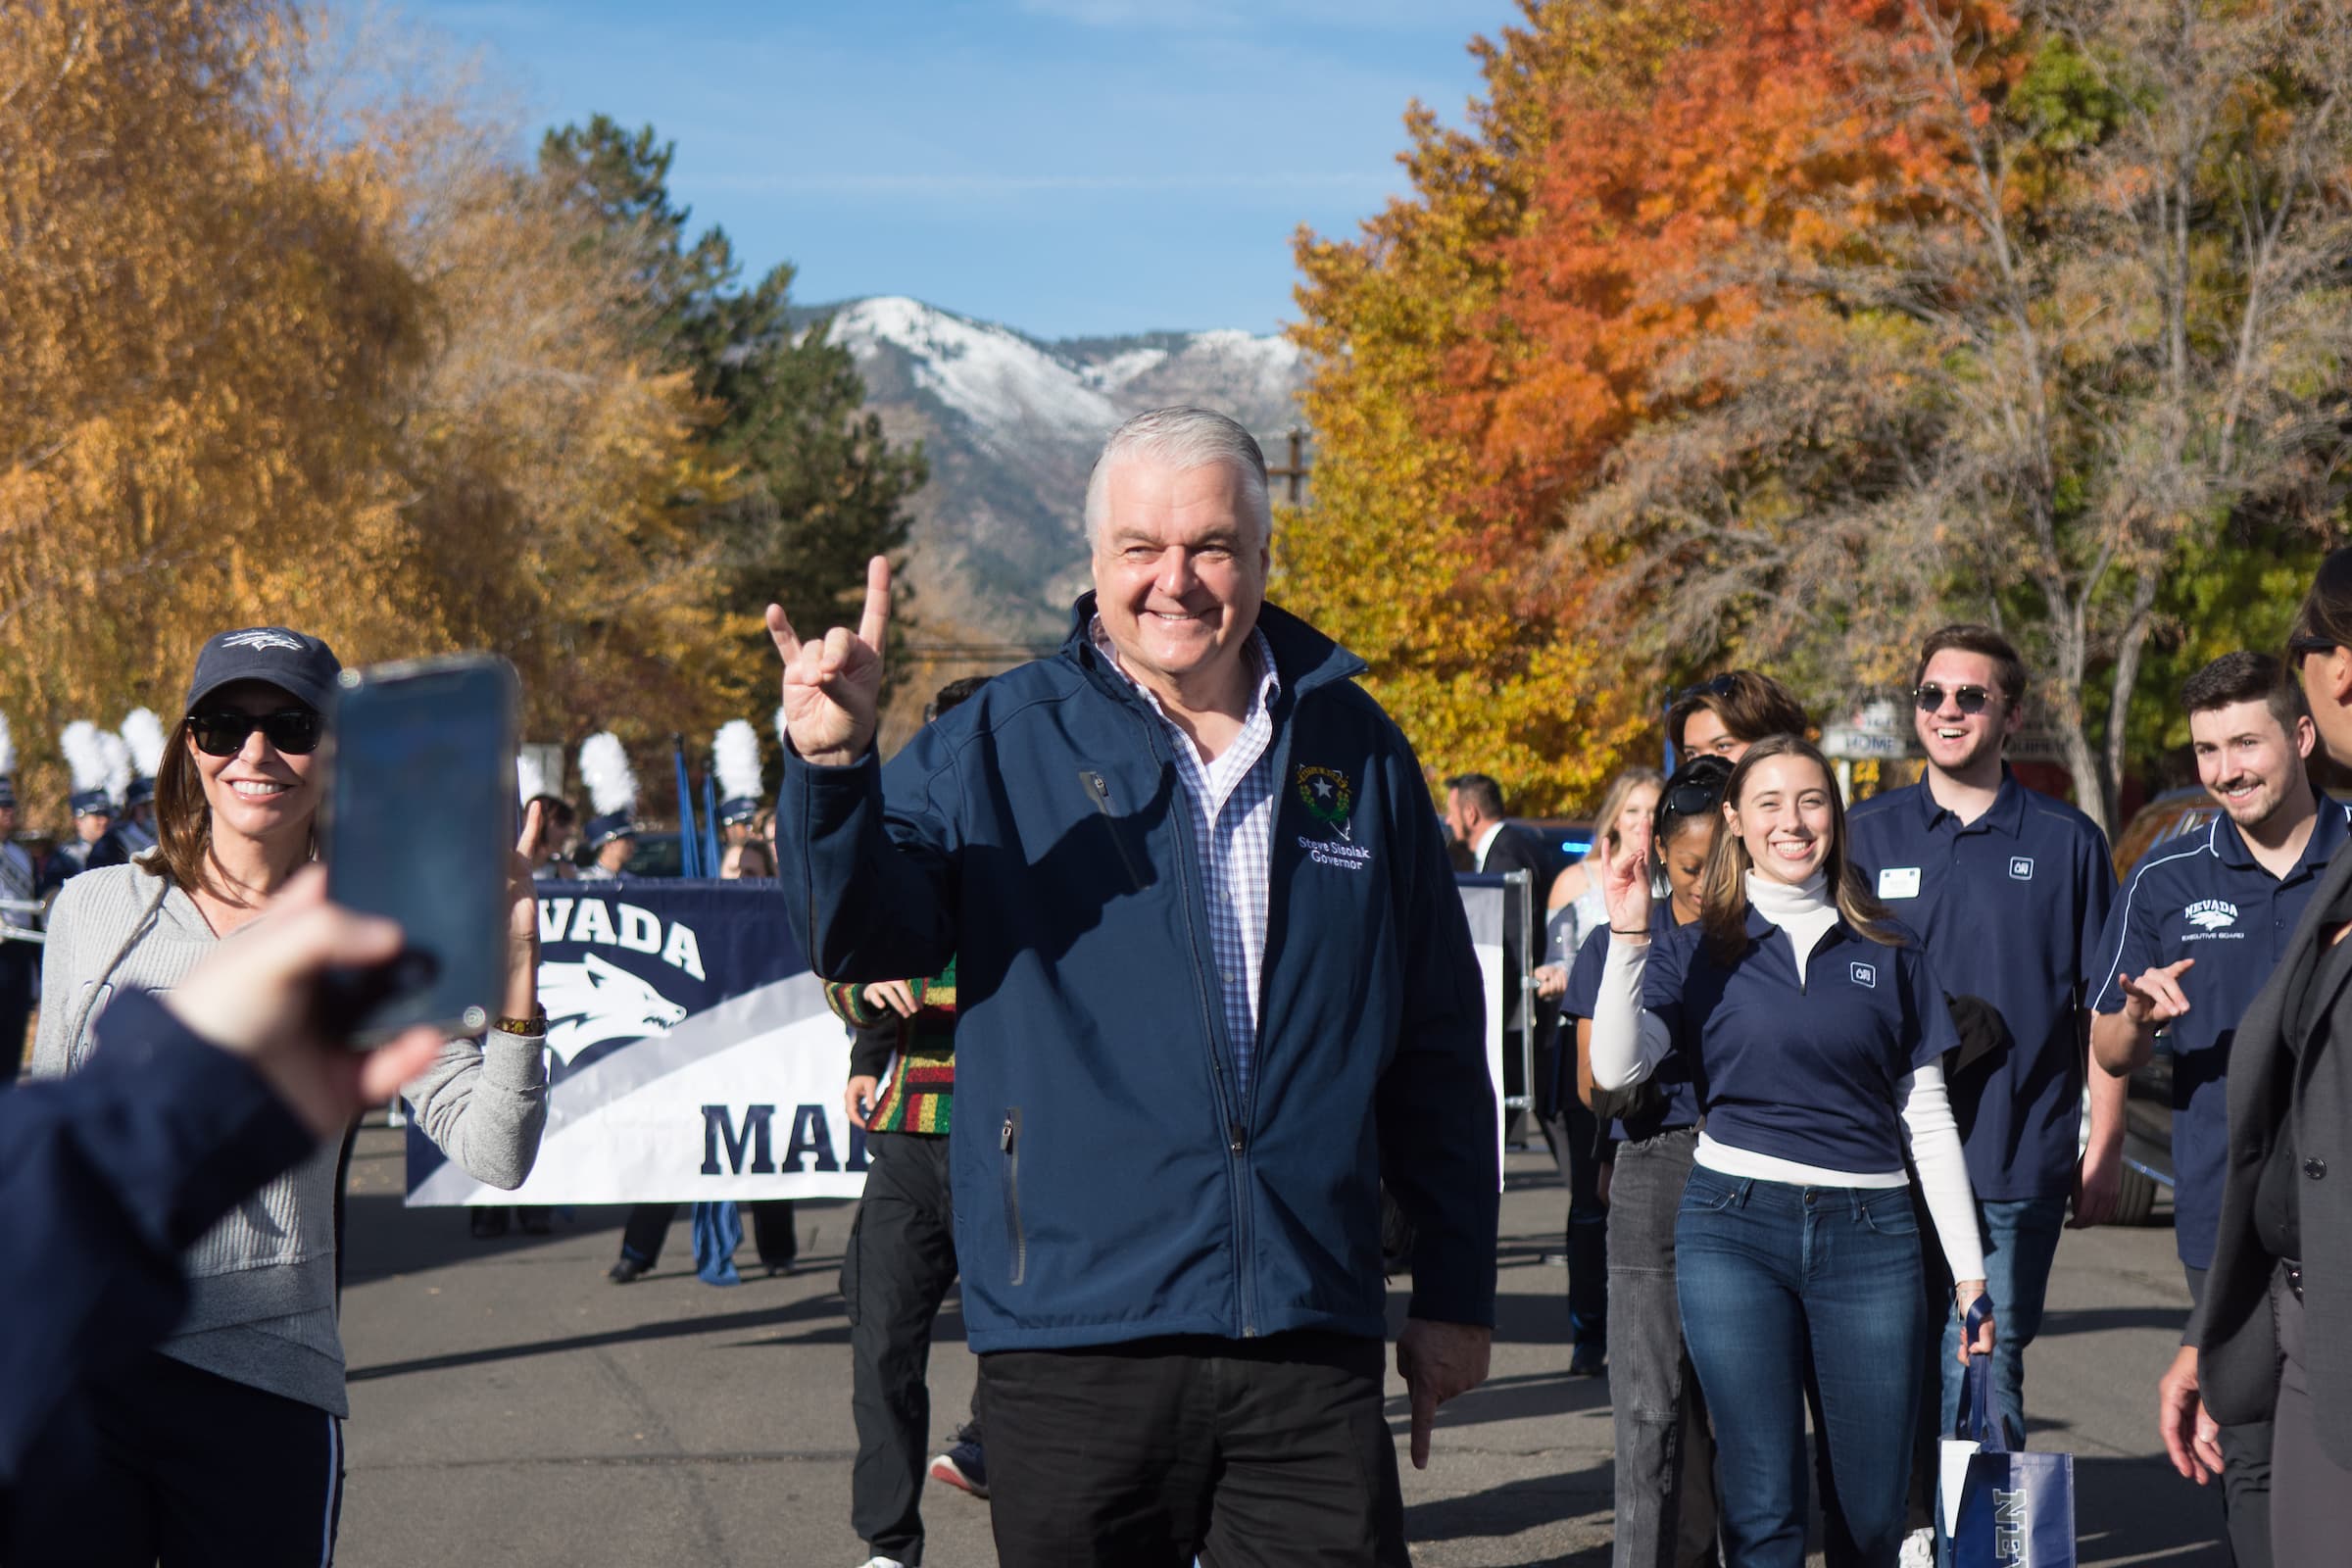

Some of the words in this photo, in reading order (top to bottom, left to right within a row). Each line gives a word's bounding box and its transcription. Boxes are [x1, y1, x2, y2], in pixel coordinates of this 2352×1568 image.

[1298, 836, 1330, 852] Steve
[1331, 842, 1372, 859] Sisolak
[1310, 850, 1364, 870] Governor
[2184, 899, 2238, 919] NEVADA
[538, 898, 707, 982] VADA
[1992, 1488, 2029, 1568] NE
